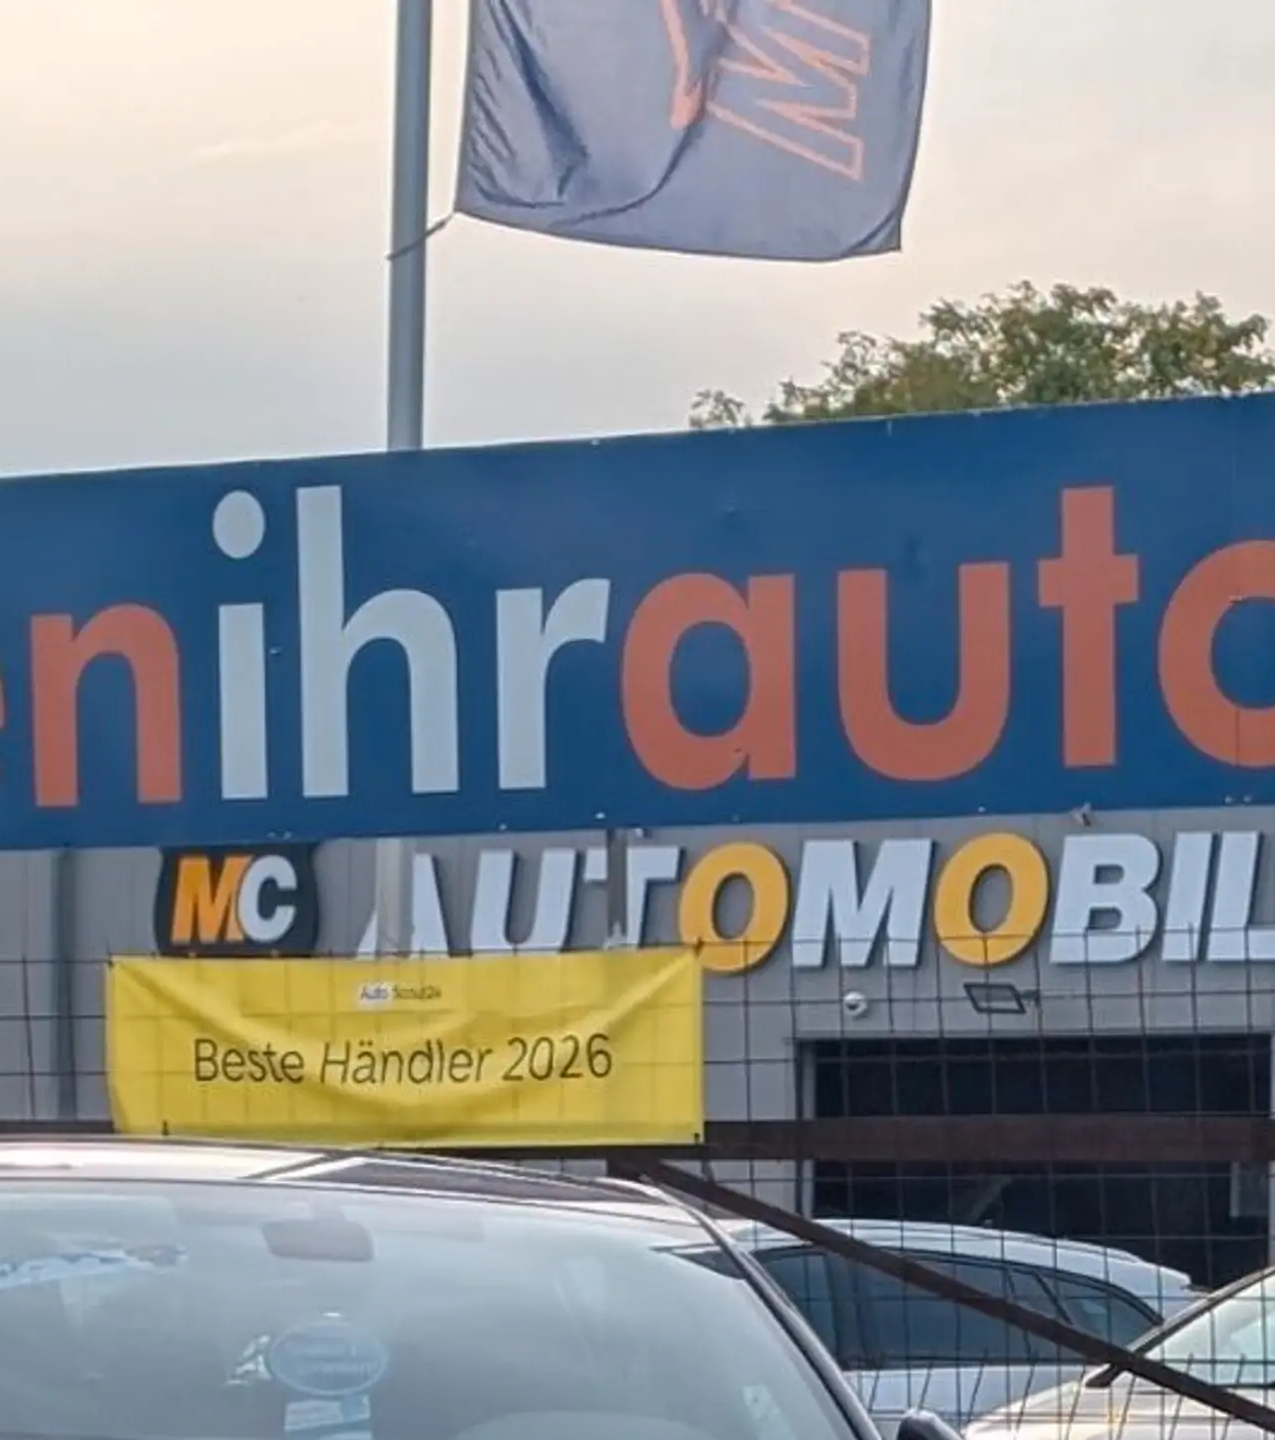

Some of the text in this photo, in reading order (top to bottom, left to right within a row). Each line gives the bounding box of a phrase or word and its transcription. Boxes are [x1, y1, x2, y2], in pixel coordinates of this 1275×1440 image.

[170, 853, 298, 945] MC
[193, 1033, 613, 1085] Beste Händler 2026
